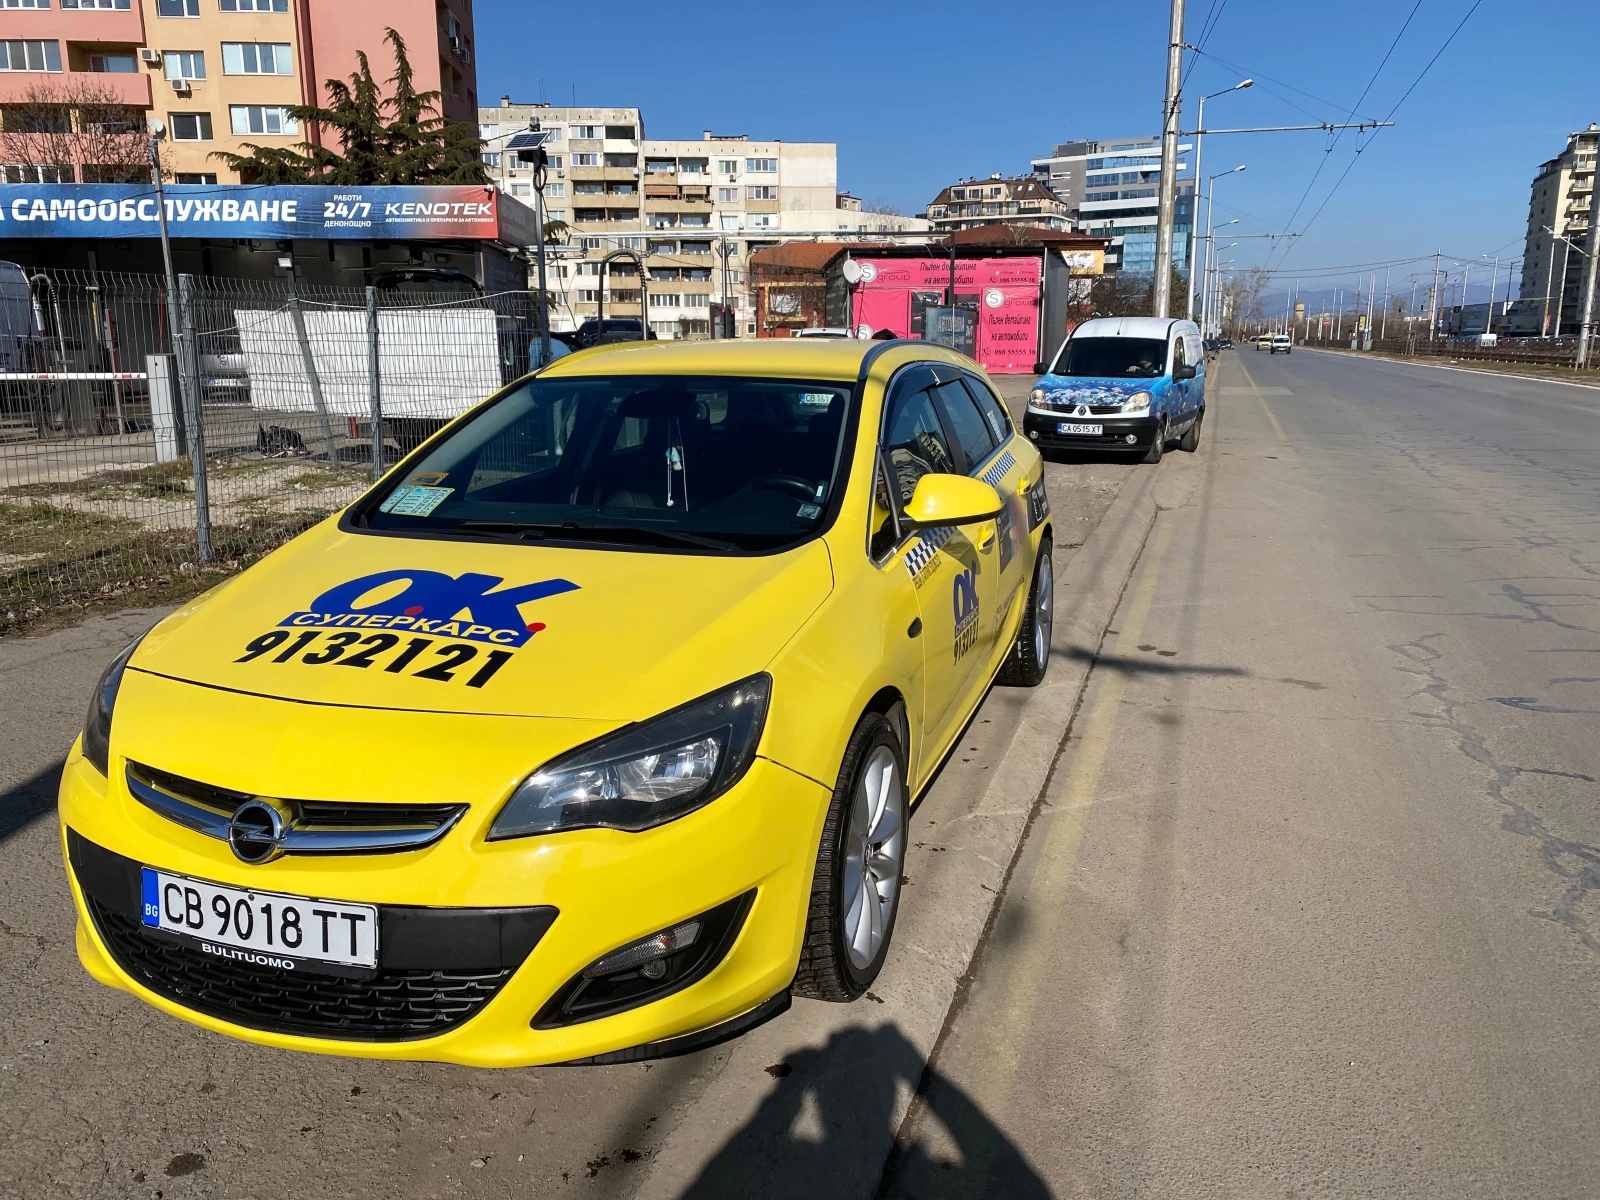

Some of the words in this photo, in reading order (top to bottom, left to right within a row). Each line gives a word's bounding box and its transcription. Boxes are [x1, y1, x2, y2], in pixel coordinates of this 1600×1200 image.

[333, 194, 362, 202] РАБОТИ
[11, 198, 298, 222] САМООБСЛУЖВАНЕ
[323, 202, 372, 219] 24/7
[384, 202, 494, 216] KENOTEK
[323, 220, 372, 228] ДЕНОНОЩНО
[920, 262, 940, 271] Пълен
[862, 265, 871, 278] S
[876, 273, 911, 283] group
[924, 276, 932, 284] на
[933, 276, 974, 284] автообили
[990, 293, 999, 304] S
[988, 314, 1004, 325] Пълен
[991, 333, 998, 341] на
[1062, 424, 1071, 432] CA
[1072, 424, 1090, 433] 0515
[1091, 426, 1101, 434] XT
[292, 613, 520, 643] СУПЕРКАРС
[953, 617, 979, 666] 9132121
[231, 630, 515, 689] 9132121
[145, 903, 158, 918] BG
[164, 882, 204, 930] CB
[211, 894, 303, 949] 9018
[312, 908, 366, 957] TT
[202, 942, 296, 970] BULITUOMO
